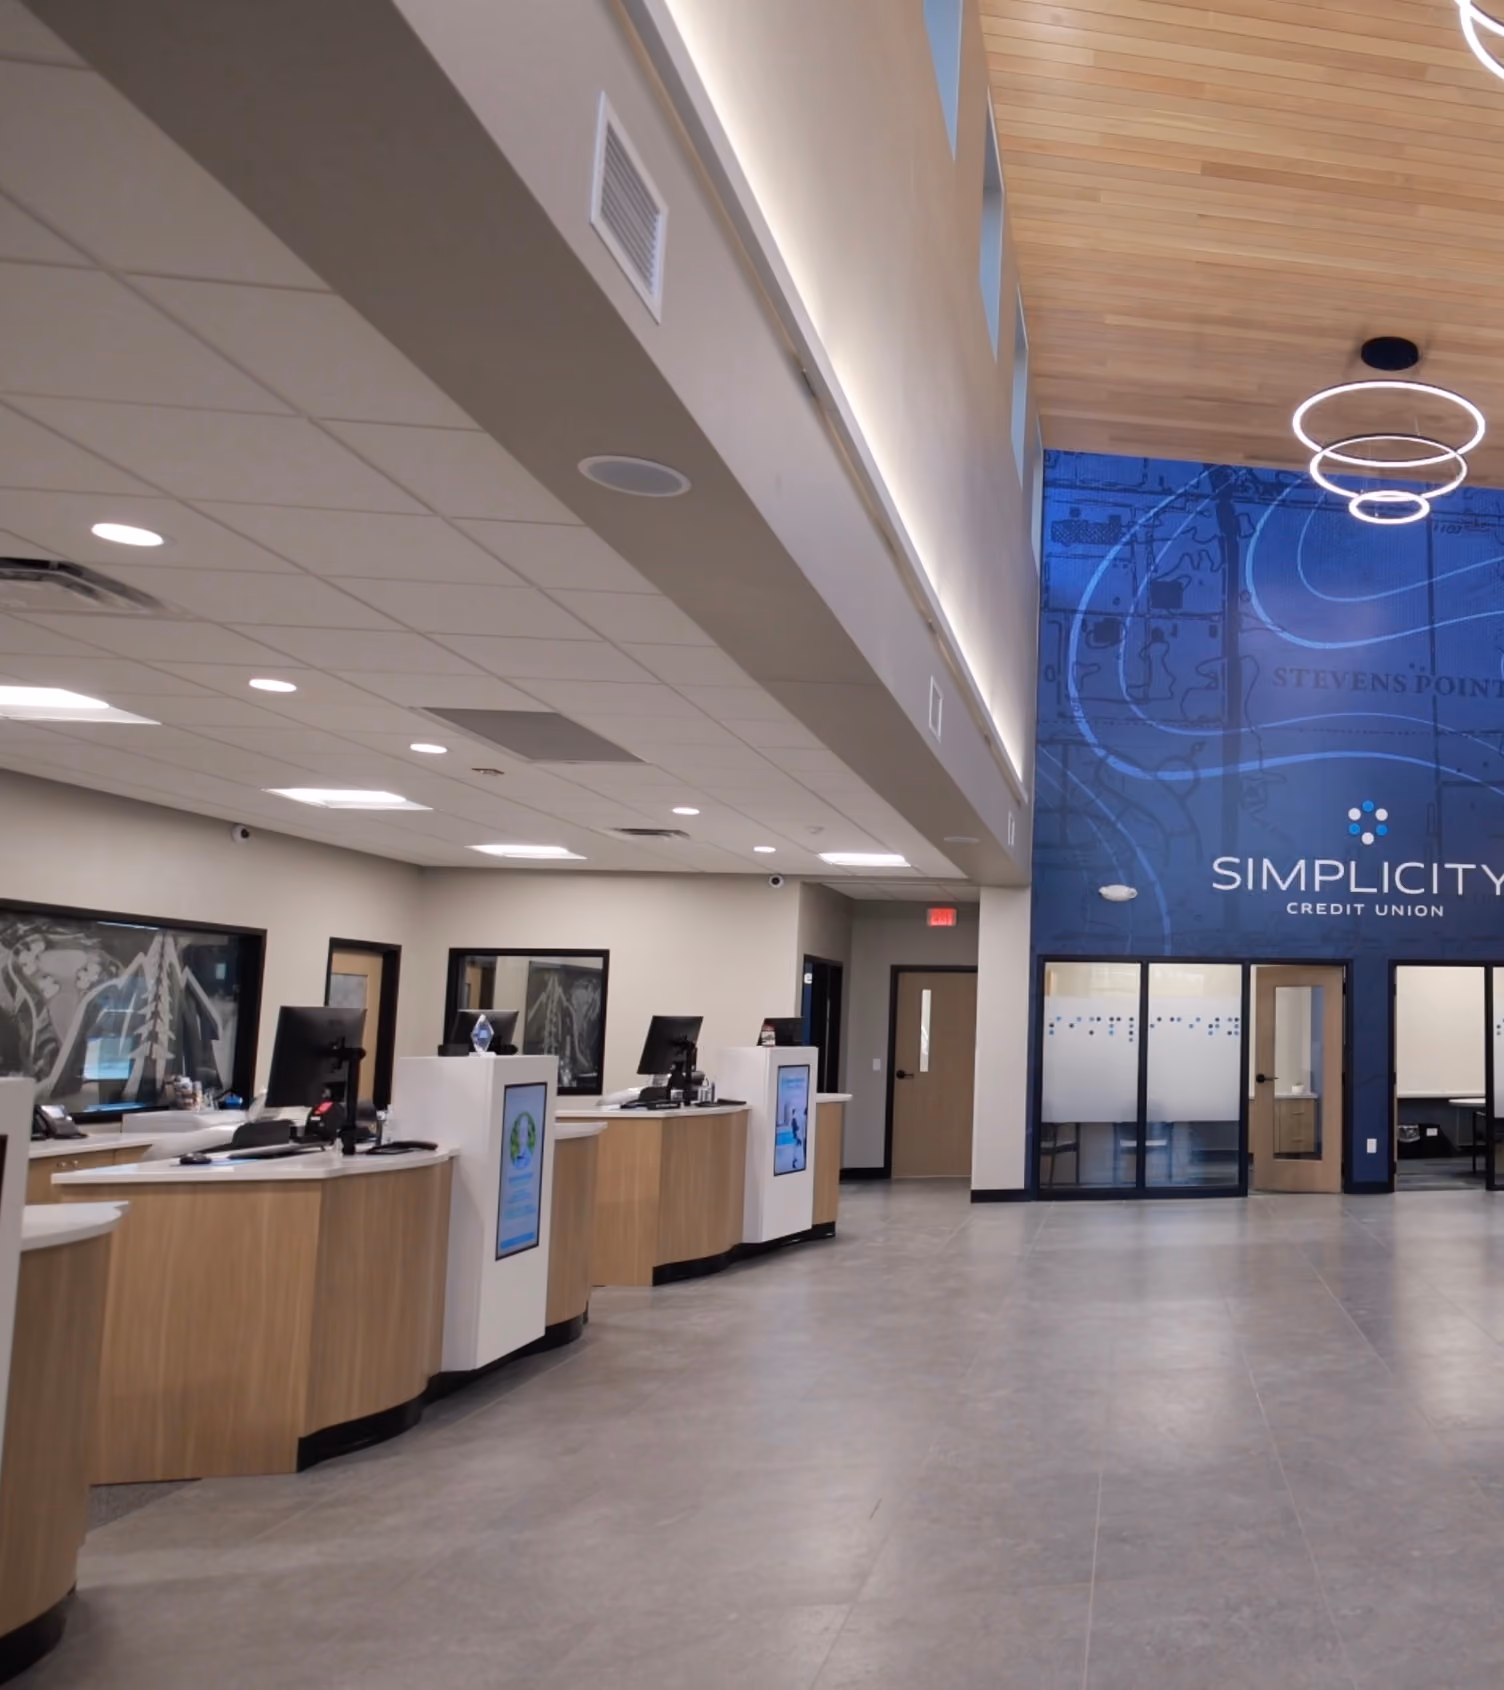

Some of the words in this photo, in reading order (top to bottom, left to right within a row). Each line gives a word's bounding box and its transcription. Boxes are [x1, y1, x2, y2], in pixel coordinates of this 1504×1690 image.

[1273, 667, 1407, 693] STEVENS
[1286, 902, 1366, 916] CREDIT
[1375, 903, 1444, 917] UNION
